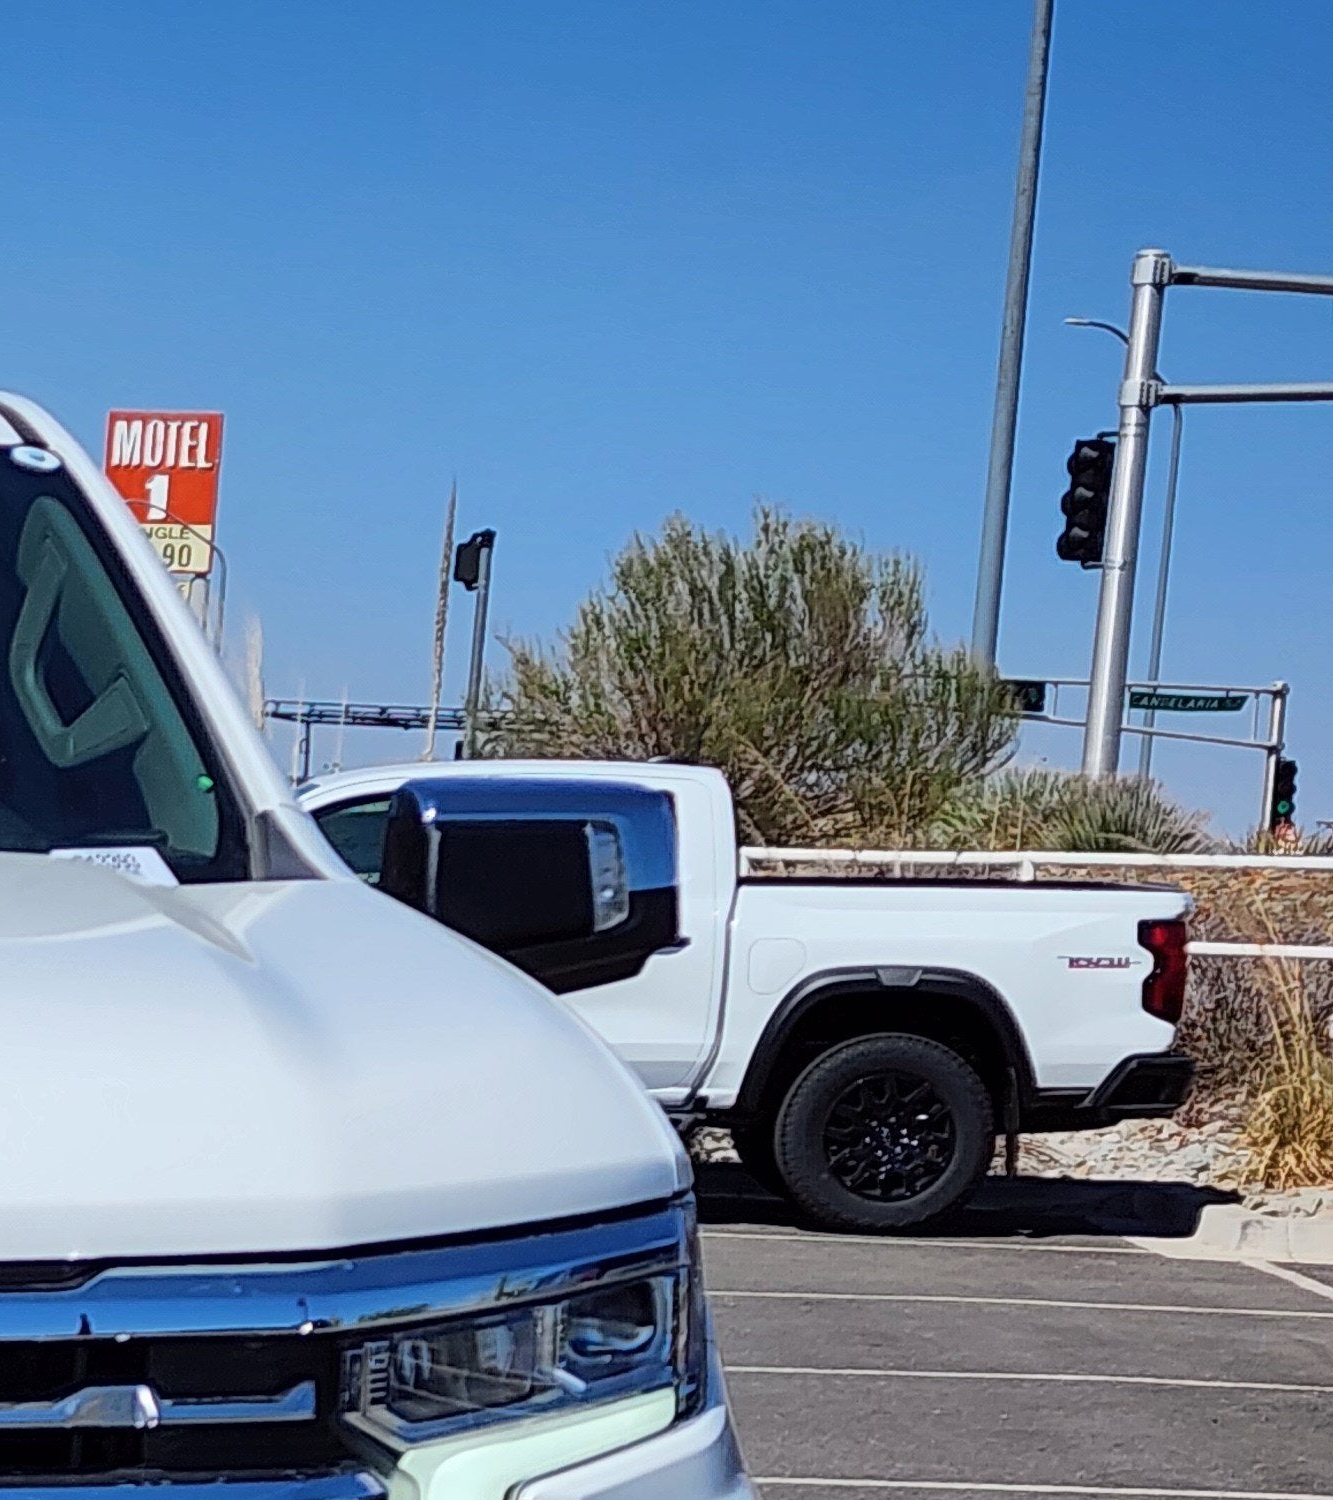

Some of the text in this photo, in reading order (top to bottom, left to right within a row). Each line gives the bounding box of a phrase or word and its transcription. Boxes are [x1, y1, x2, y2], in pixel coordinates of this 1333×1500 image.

[110, 419, 213, 469] MOTEL
[144, 474, 170, 520] 1
[141, 526, 191, 540] NGLE
